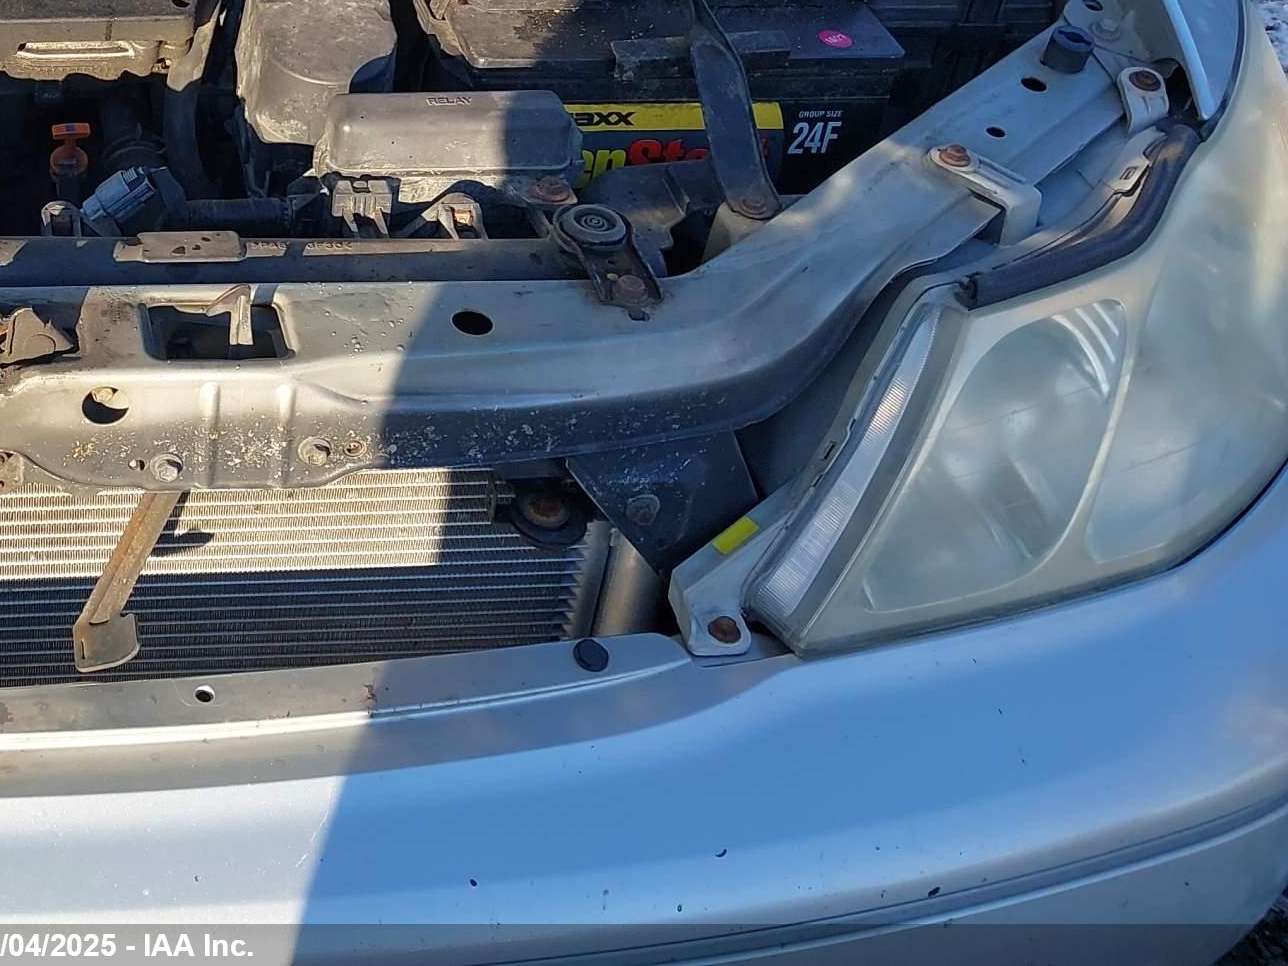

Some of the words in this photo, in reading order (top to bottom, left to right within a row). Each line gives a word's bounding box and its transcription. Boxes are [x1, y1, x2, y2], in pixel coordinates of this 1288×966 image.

[425, 96, 473, 106] RELAY
[569, 111, 636, 126] axx
[798, 110, 826, 118] GROUP
[826, 110, 843, 118] SIZE
[787, 121, 843, 154] 24F
